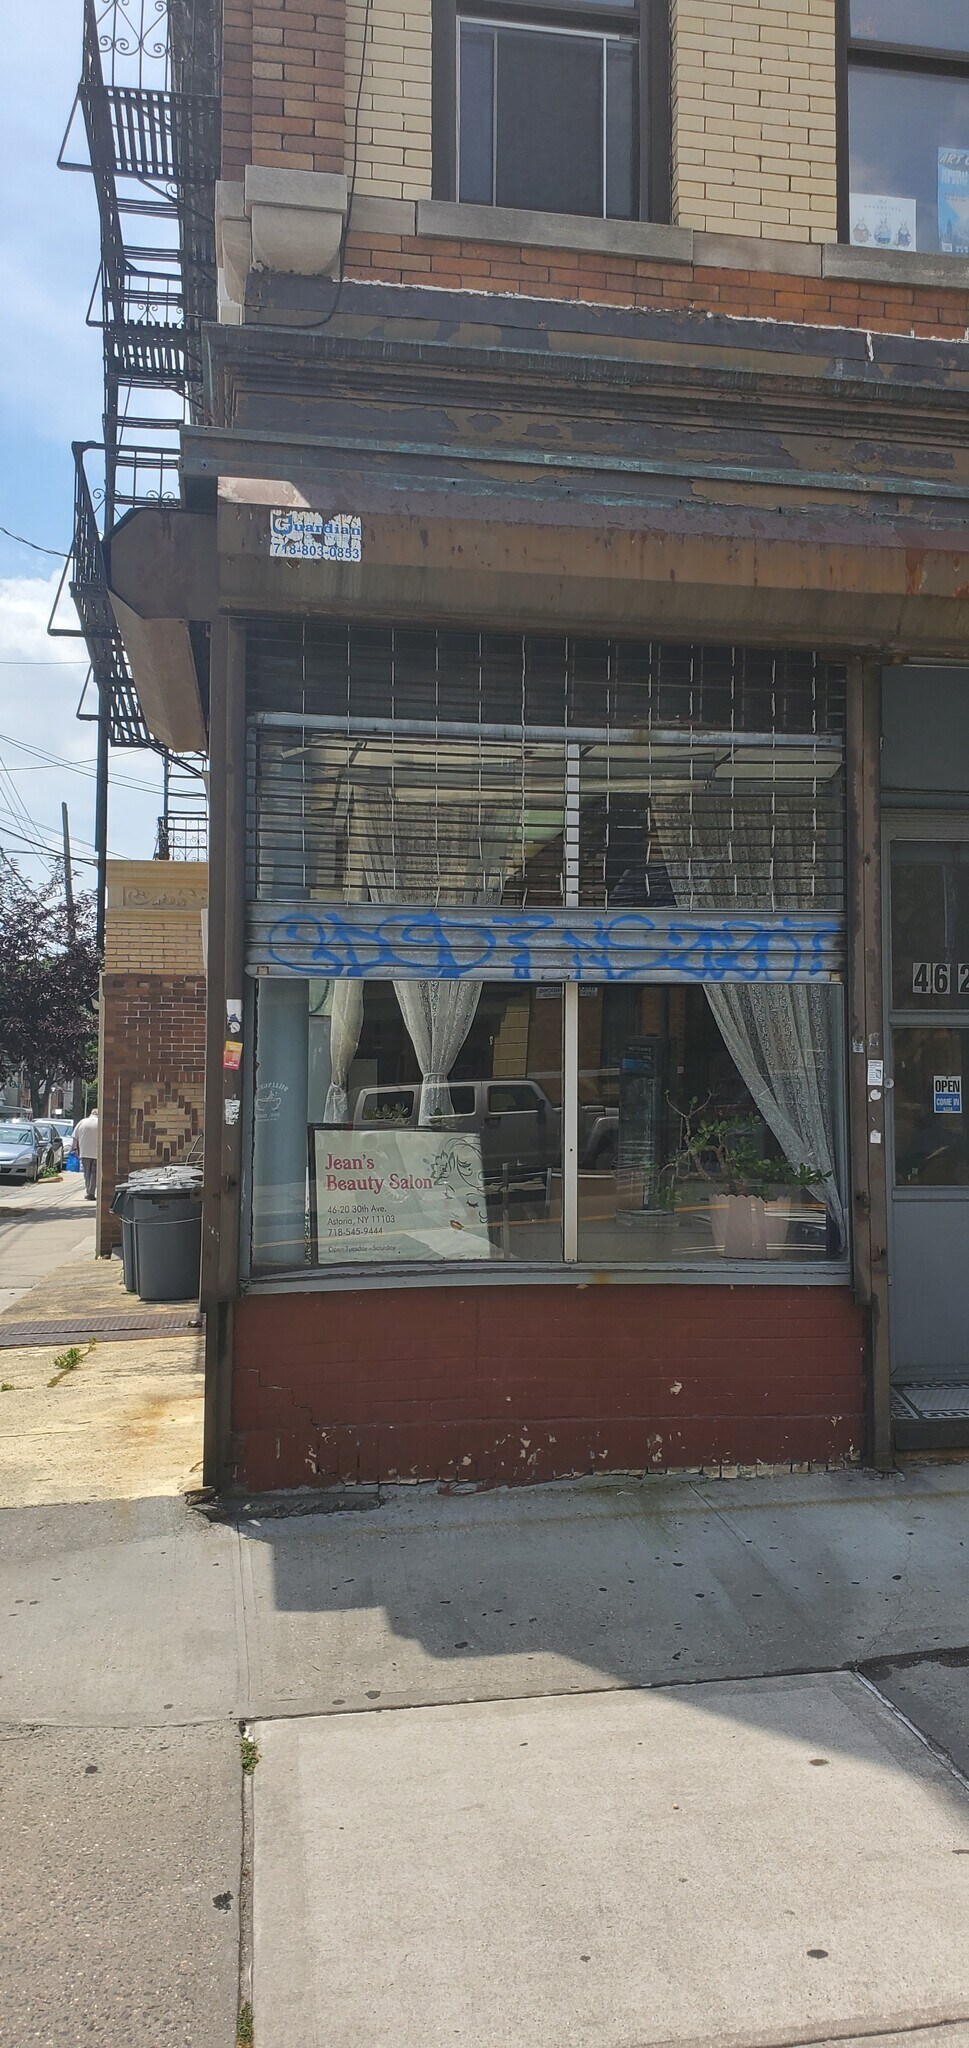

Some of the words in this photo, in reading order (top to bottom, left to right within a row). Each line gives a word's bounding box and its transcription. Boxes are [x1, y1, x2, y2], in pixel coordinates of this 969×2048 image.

[272, 513, 361, 535] Guardian
[273, 542, 360, 559] 718-803-0853
[935, 1080, 960, 1093] OPEN
[936, 1097, 952, 1106] COME
[953, 1097, 960, 1106] IN
[325, 1153, 375, 1171] Jean's
[325, 1174, 384, 1194] Beauty
[389, 1173, 434, 1190] Salon
[327, 1205, 350, 1214] 46-20
[352, 1204, 369, 1213] 30th
[371, 1204, 387, 1213] Ave.
[327, 1217, 355, 1226] Astoria,
[357, 1216, 369, 1224] NY
[372, 1215, 396, 1223] 11103
[328, 1227, 383, 1236] 718-545-9444
[345, 1245, 368, 1253] Tuesday
